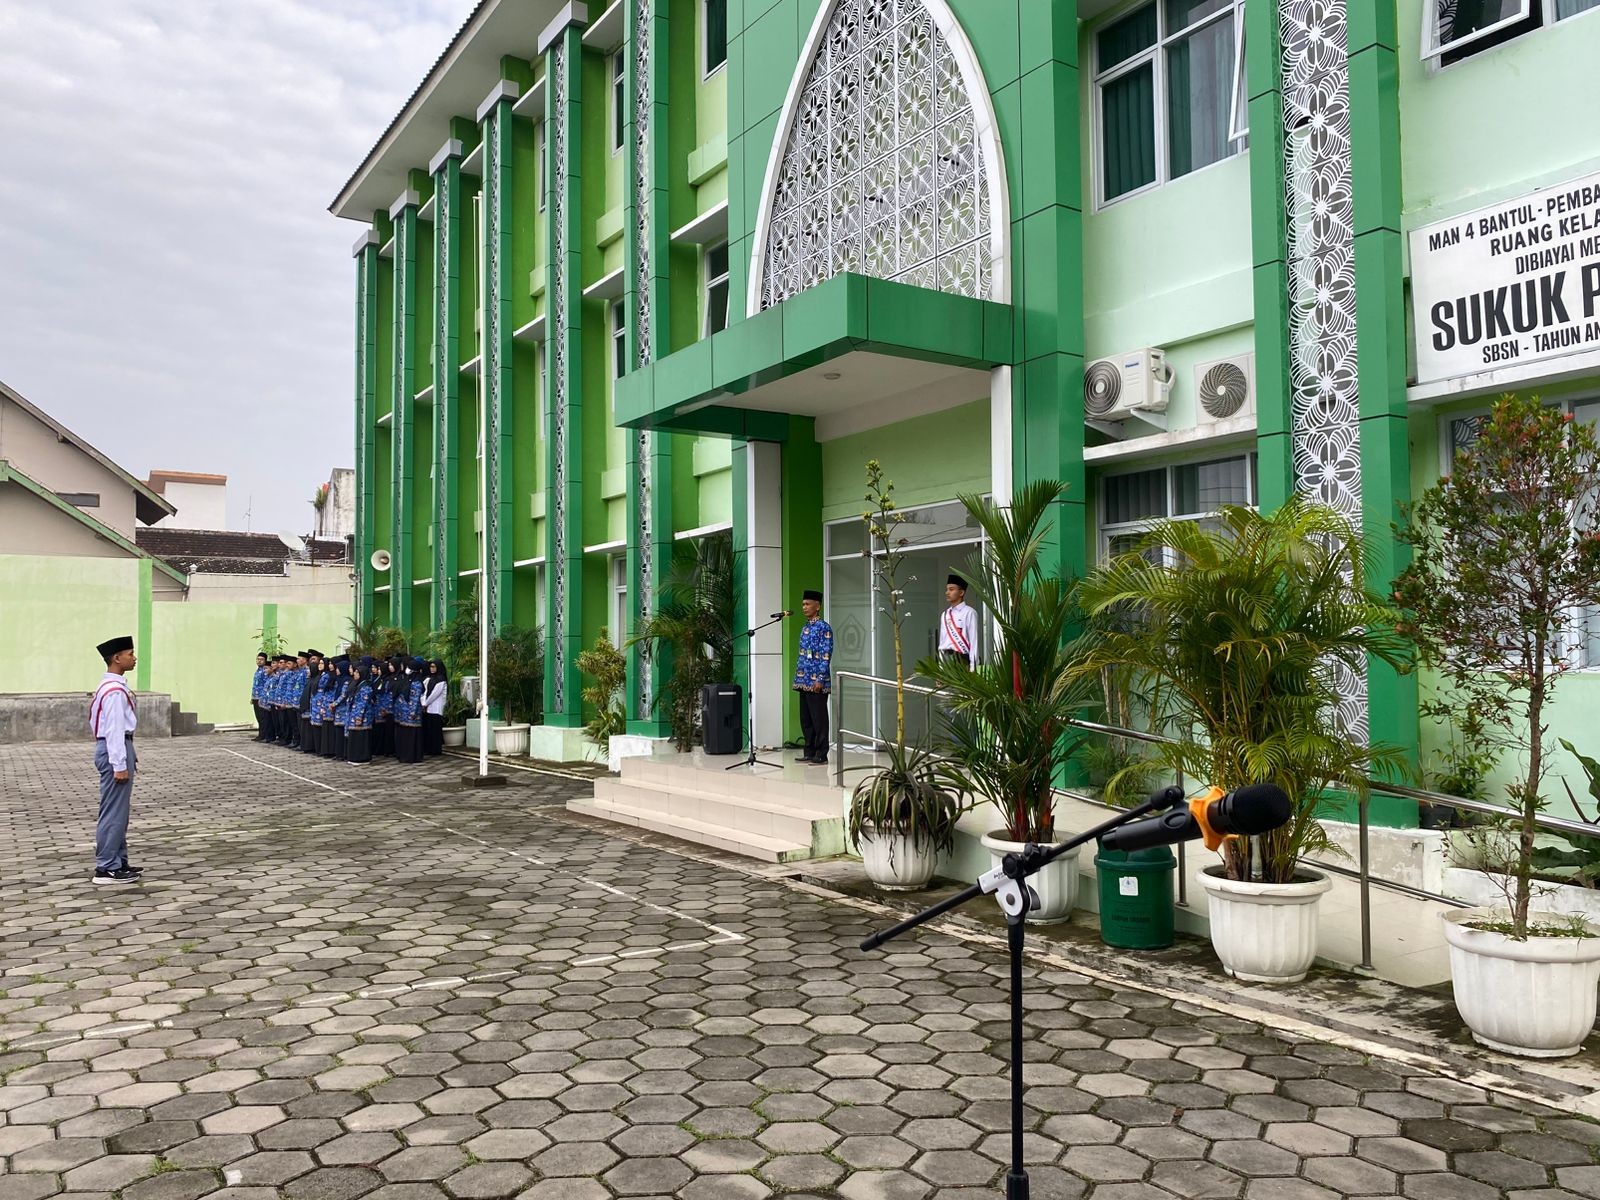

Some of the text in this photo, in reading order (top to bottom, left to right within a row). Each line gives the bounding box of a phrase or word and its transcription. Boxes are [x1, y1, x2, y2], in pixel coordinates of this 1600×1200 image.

[1429, 227, 1460, 251] MAN
[1465, 222, 1475, 239] 4
[1479, 204, 1536, 236] BANTUL
[1546, 184, 1600, 216] PEMBA
[1490, 223, 1552, 256] RUANG
[1515, 242, 1574, 275] DIBIAYAI
[1430, 270, 1571, 352] SUKUK
[1482, 340, 1519, 363] SBSN
[1533, 325, 1581, 353] TAHUN
